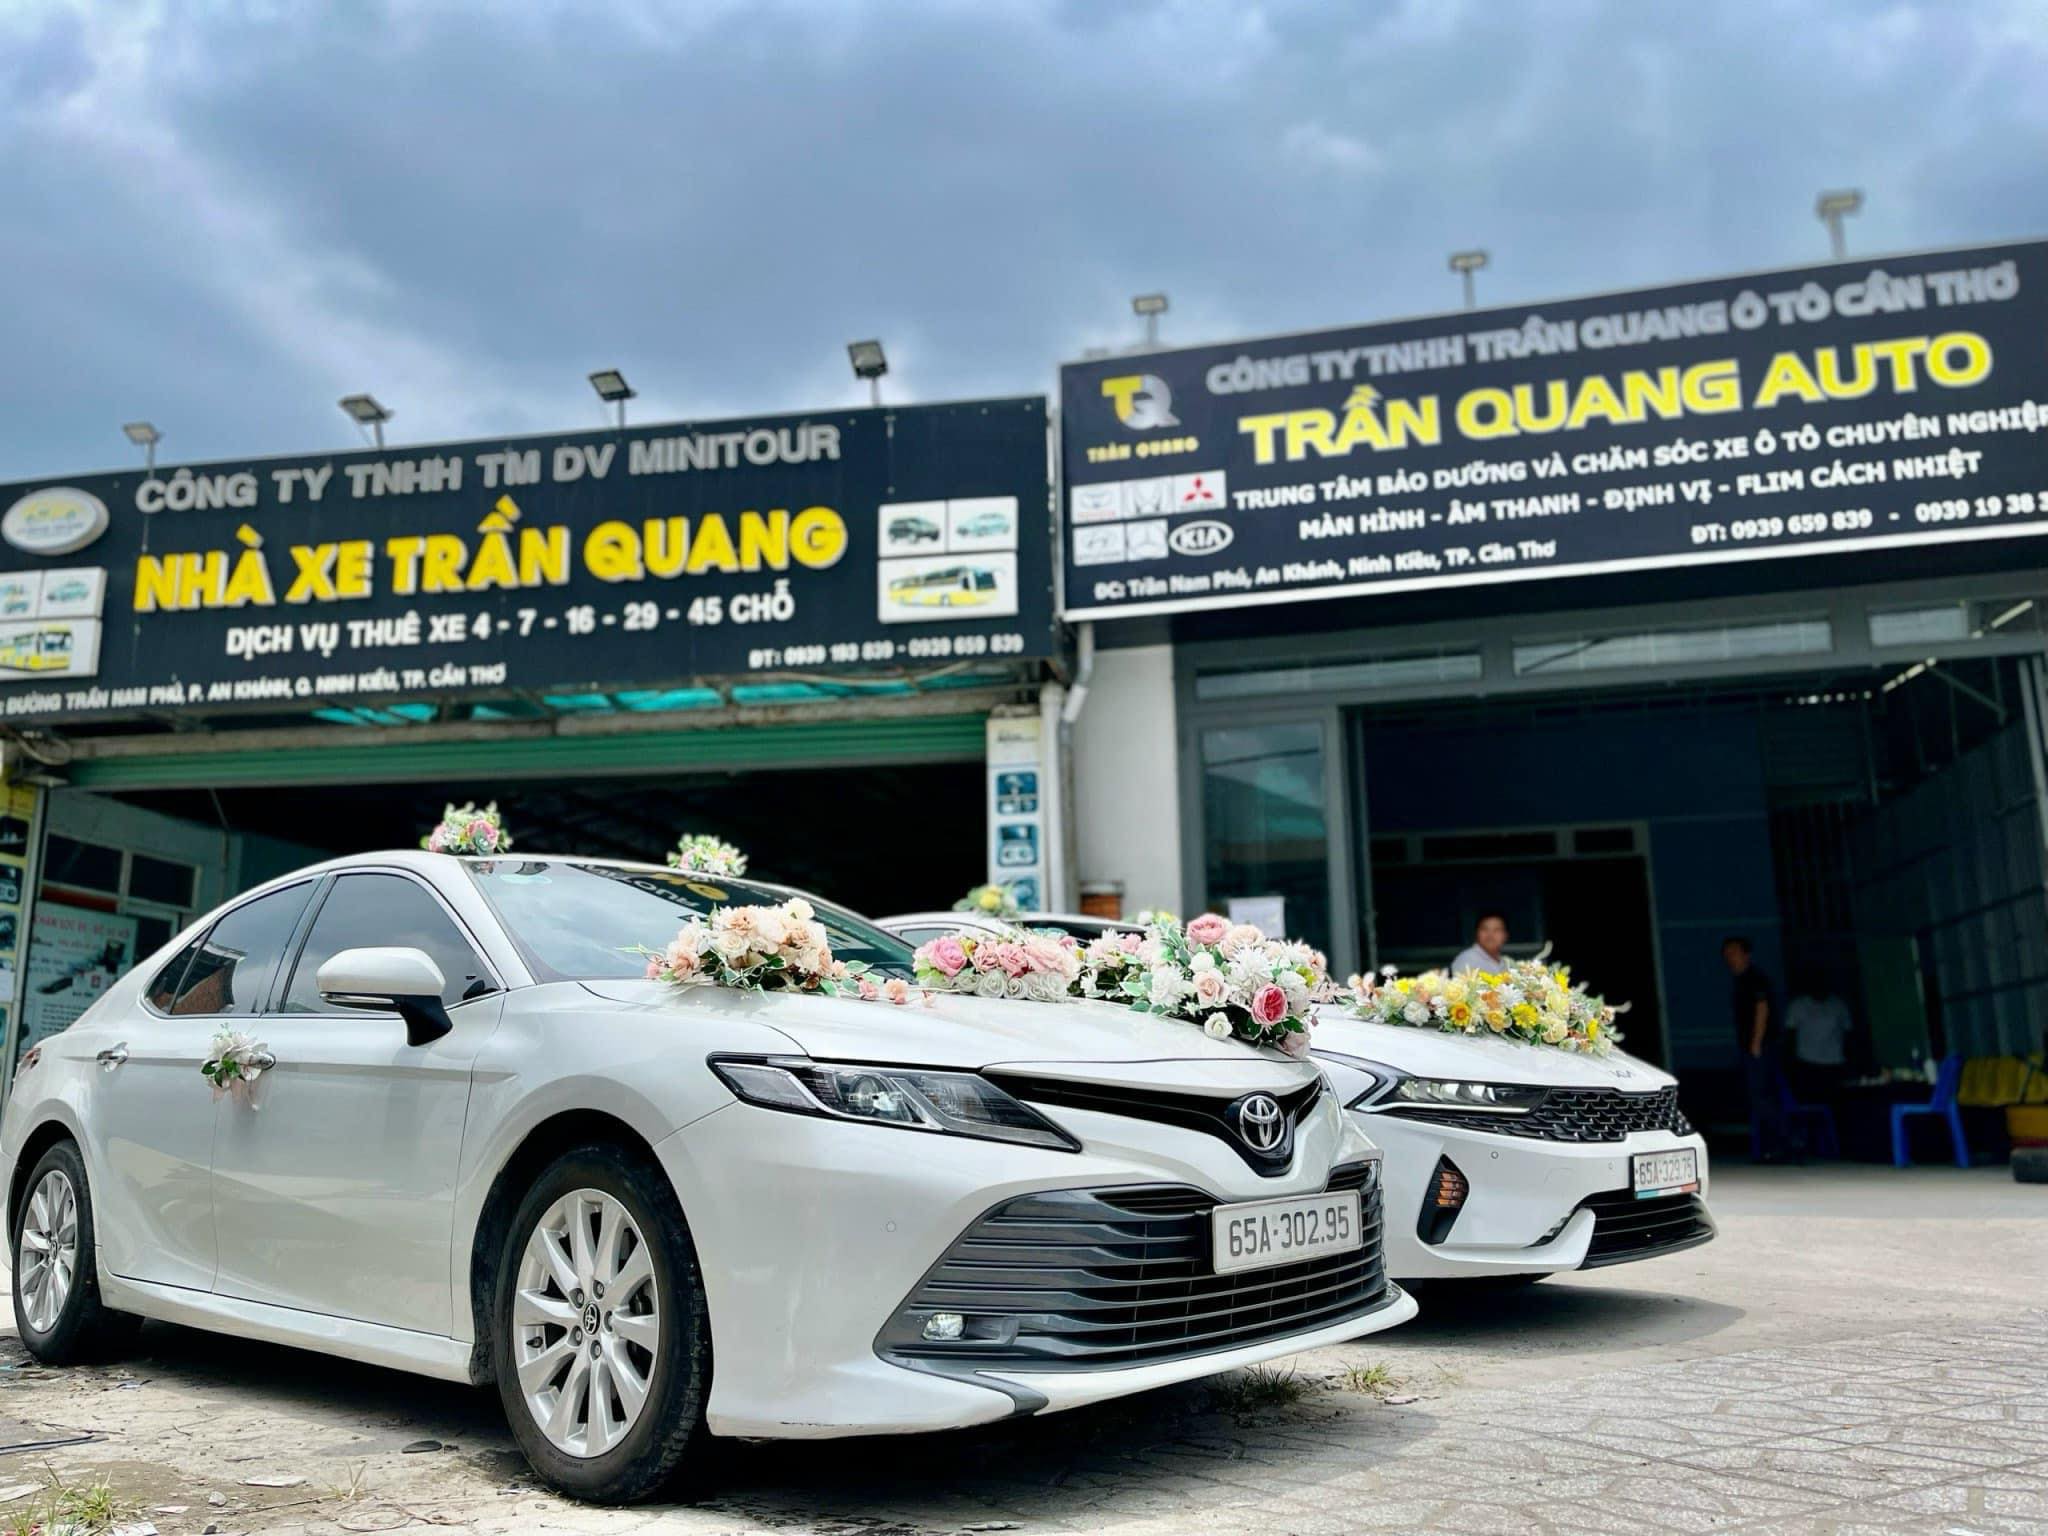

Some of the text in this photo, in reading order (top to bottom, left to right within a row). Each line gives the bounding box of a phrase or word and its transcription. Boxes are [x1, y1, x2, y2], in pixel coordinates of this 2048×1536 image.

[1205, 356, 1310, 395] CÔNG
[1311, 349, 1361, 383] TY
[1362, 334, 1466, 377] TNHH
[1580, 300, 1729, 349] QUANG
[1731, 289, 1768, 330] Ô
[1768, 282, 1831, 325] TÔ
[1925, 260, 2020, 306] THƠ
[1238, 331, 1993, 464] TRẦN QUANG AUTO
[136, 424, 841, 513] CÔNG TY TNHH TM DV MINITOUR
[1232, 484, 1316, 510] TRUNG
[1319, 475, 1371, 501] TÂM
[1531, 452, 1568, 478] VÀ
[1572, 445, 1648, 474] CHĂM
[1653, 437, 1709, 466] SÓC
[1713, 436, 1749, 460] XE
[1754, 428, 1776, 455] Ô
[1781, 423, 1820, 452] TÔ
[1826, 412, 1941, 447] CHUYÊN
[1300, 512, 1354, 540] MÀN
[1359, 506, 1425, 533] HÌNH
[1447, 499, 1487, 525] ÂM
[1491, 493, 1581, 520] THANH
[1604, 483, 1675, 512] ĐỊNH
[1680, 479, 1712, 504] VỊ
[1736, 470, 1804, 496] FLIM
[1810, 459, 1886, 487] CÁCH
[1893, 447, 1983, 480] NHIỆT
[134, 494, 848, 612] NHÀ XE TRẦN QUANG
[1179, 526, 1223, 551] KIA
[1731, 517, 1783, 540] 0939
[1915, 499, 1970, 523] 0939
[1255, 566, 1280, 585] An
[1348, 554, 1392, 576] Ninh
[1444, 547, 1475, 566] TP.
[226, 624, 293, 661] DỊCH
[300, 622, 340, 658] VỤ
[347, 609, 421, 648] THUÊ
[428, 611, 467, 643] XE
[472, 611, 492, 639] 4
[518, 608, 537, 637] 7
[565, 605, 596, 634] 16
[623, 601, 660, 631] 29
[687, 596, 723, 625] 45
[1229, 1206, 1350, 1257] 65A-302.95
